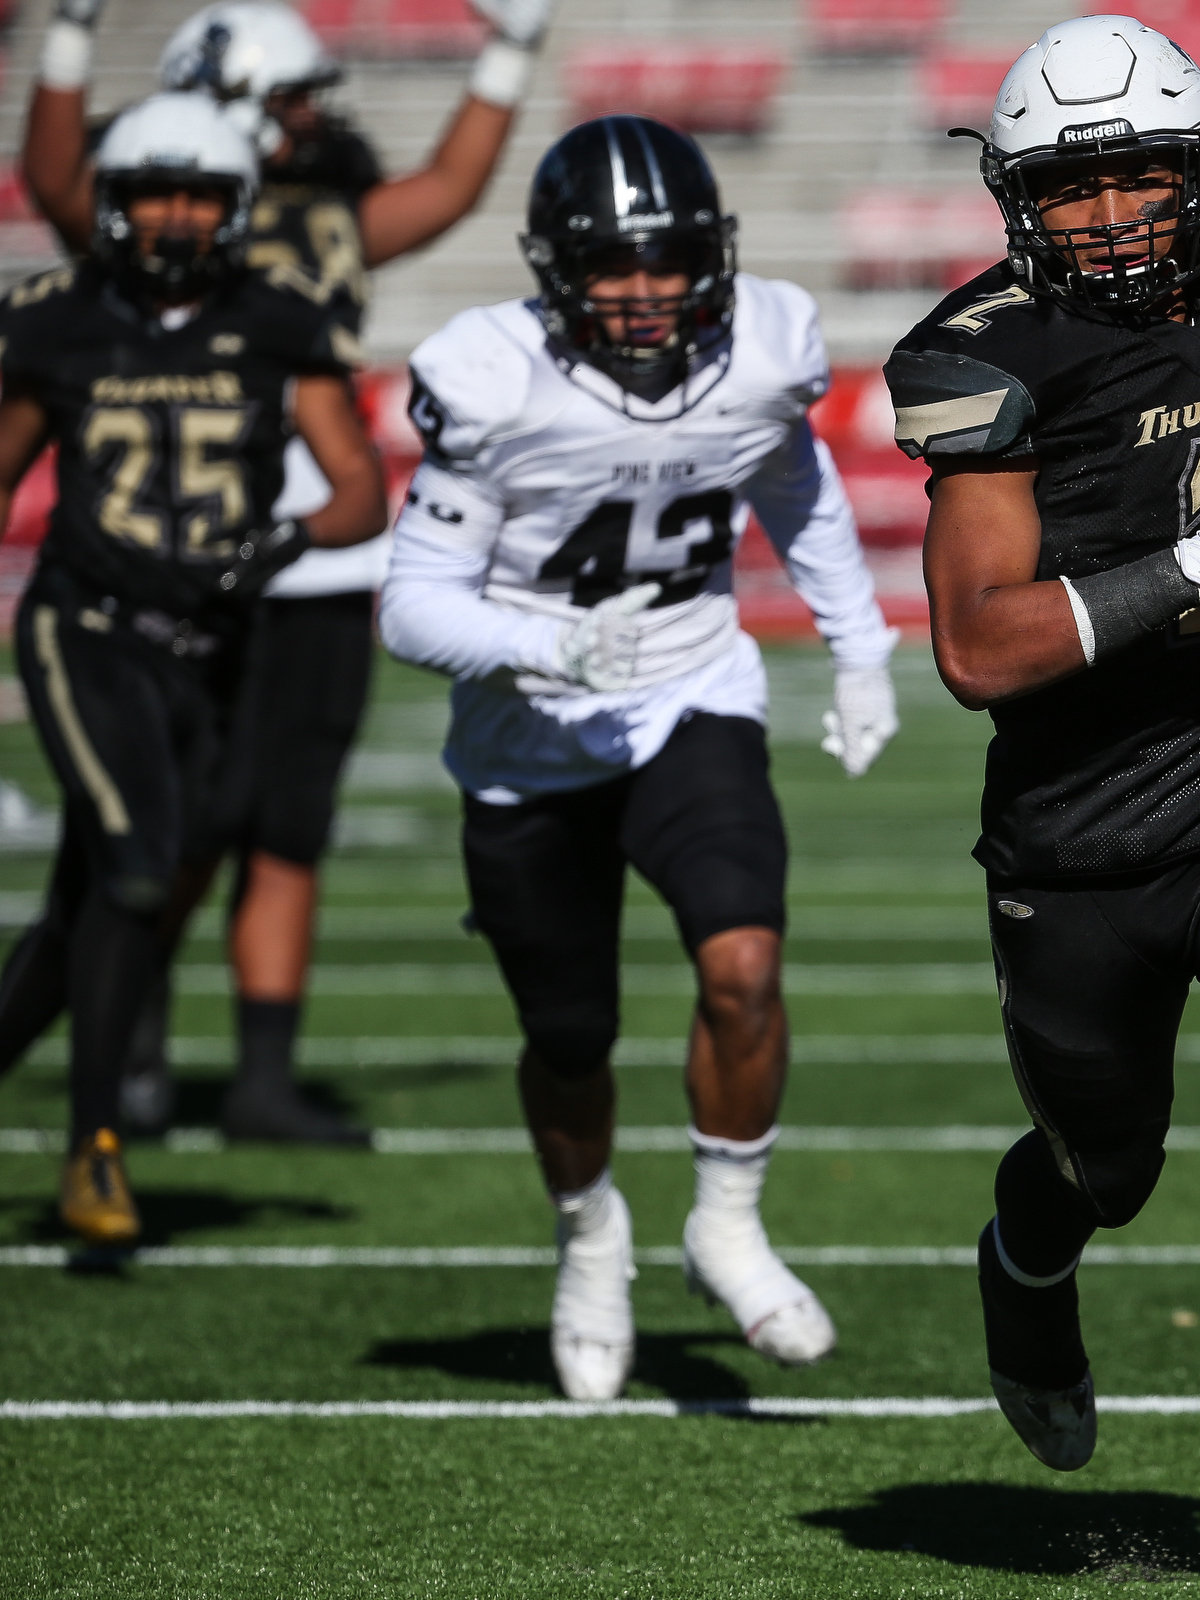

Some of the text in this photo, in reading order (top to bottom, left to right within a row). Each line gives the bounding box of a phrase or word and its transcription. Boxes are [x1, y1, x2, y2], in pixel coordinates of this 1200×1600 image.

[1064, 121, 1126, 143] Riddell
[938, 284, 1035, 336] 2
[79, 403, 256, 561] 25
[537, 489, 734, 611] 43
